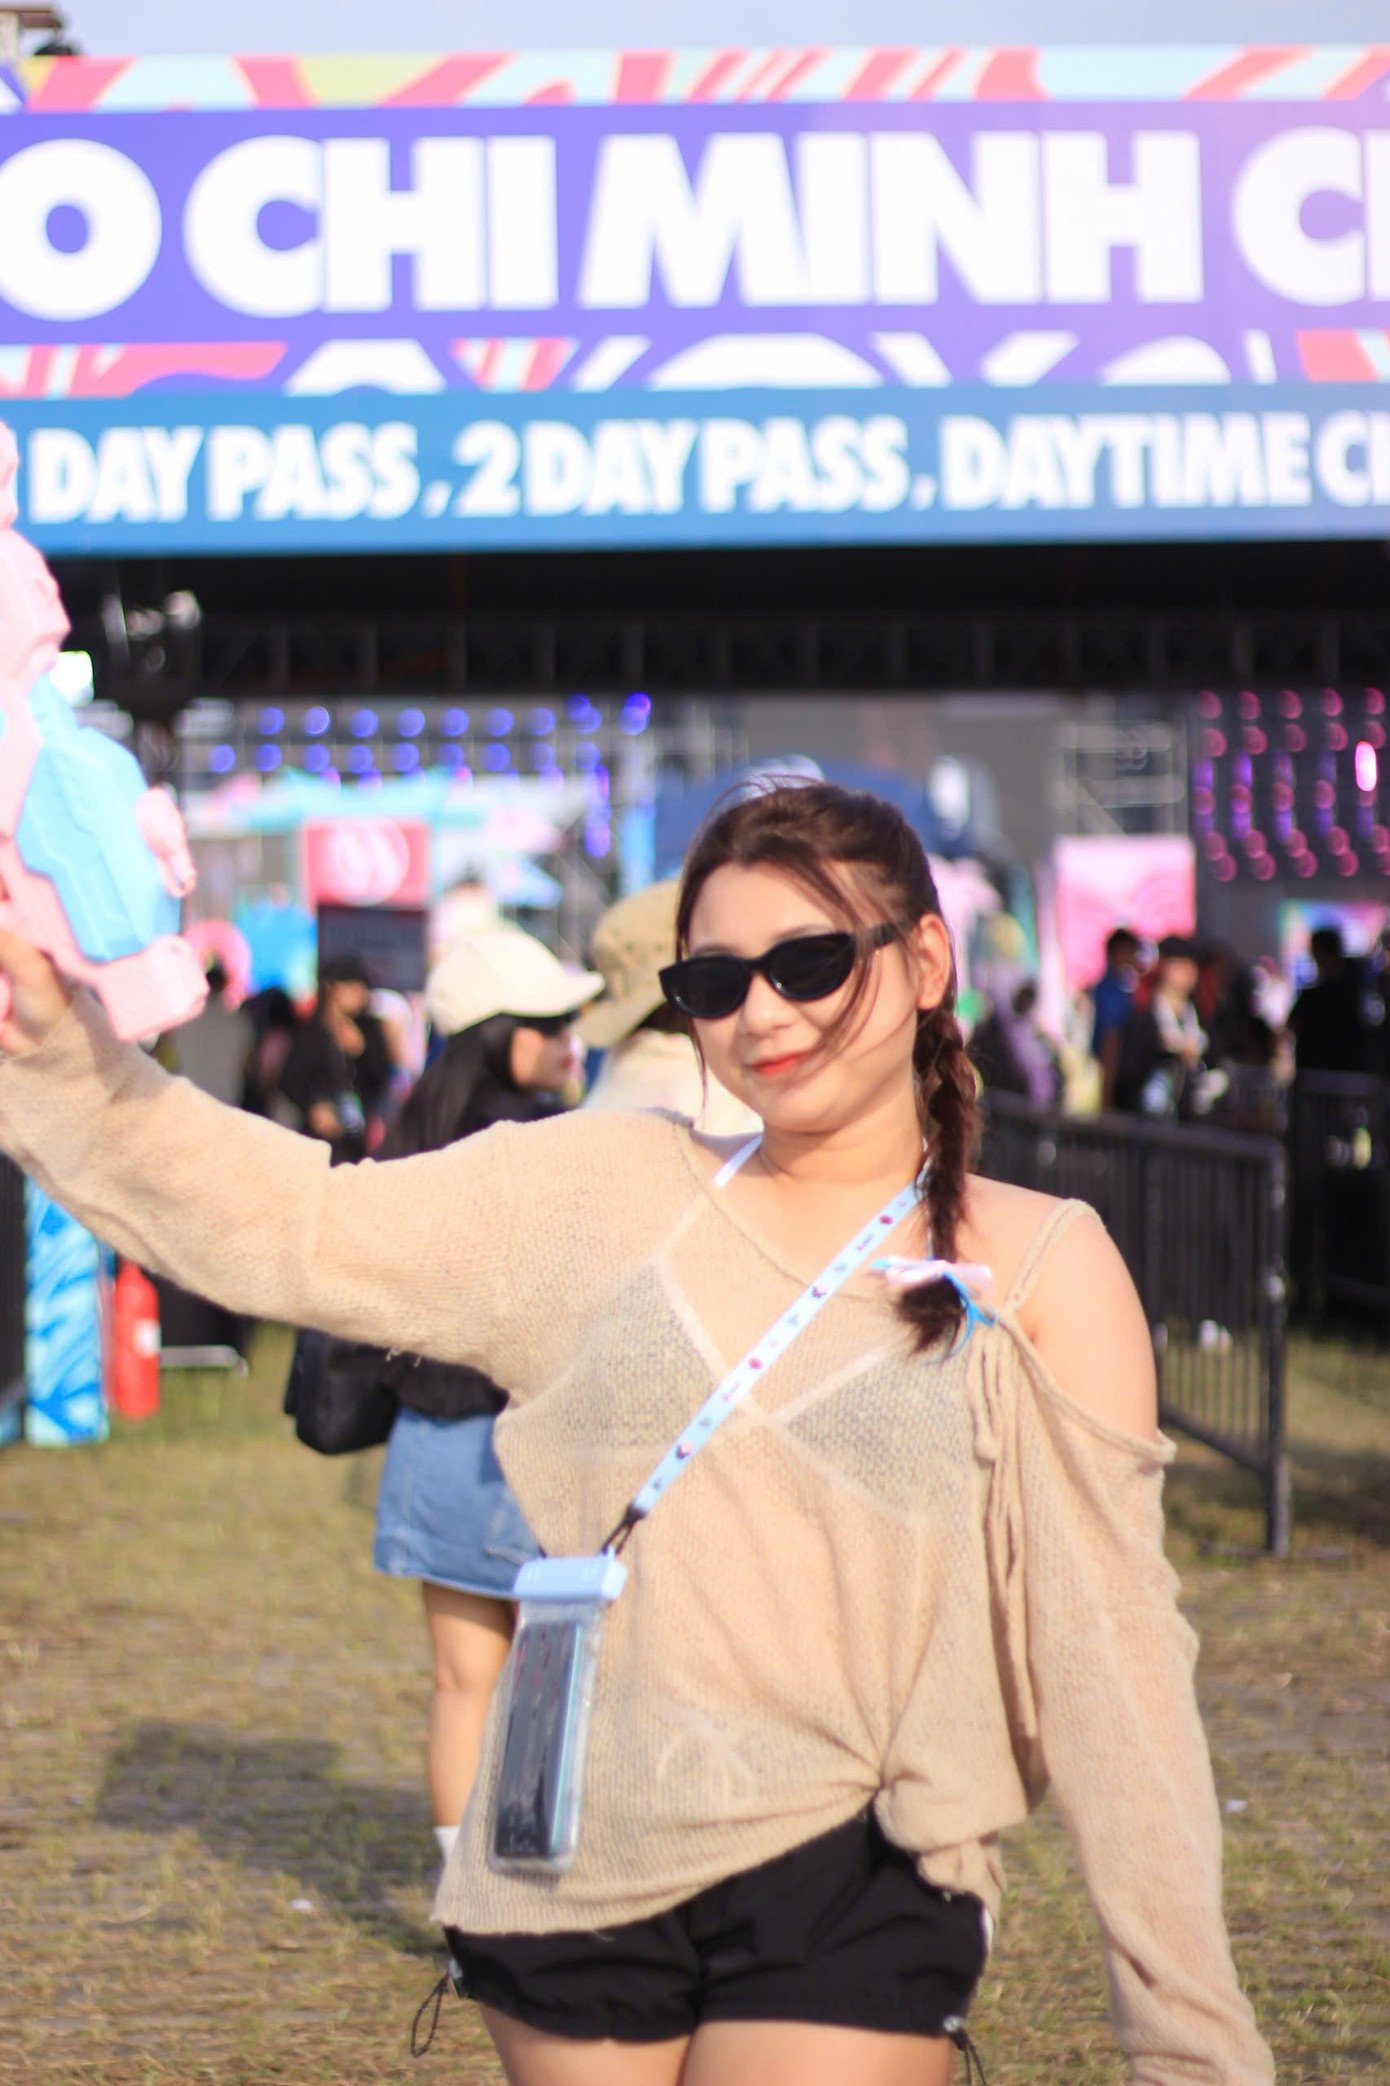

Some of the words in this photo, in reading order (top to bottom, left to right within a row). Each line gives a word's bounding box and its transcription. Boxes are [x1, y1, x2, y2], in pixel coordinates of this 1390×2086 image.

[183, 134, 558, 318] CHI
[578, 131, 1204, 309] MINH
[28, 428, 203, 523] DAY
[454, 420, 520, 517] 2
[524, 420, 699, 516] DAY
[941, 411, 1311, 510] DAYTIME
